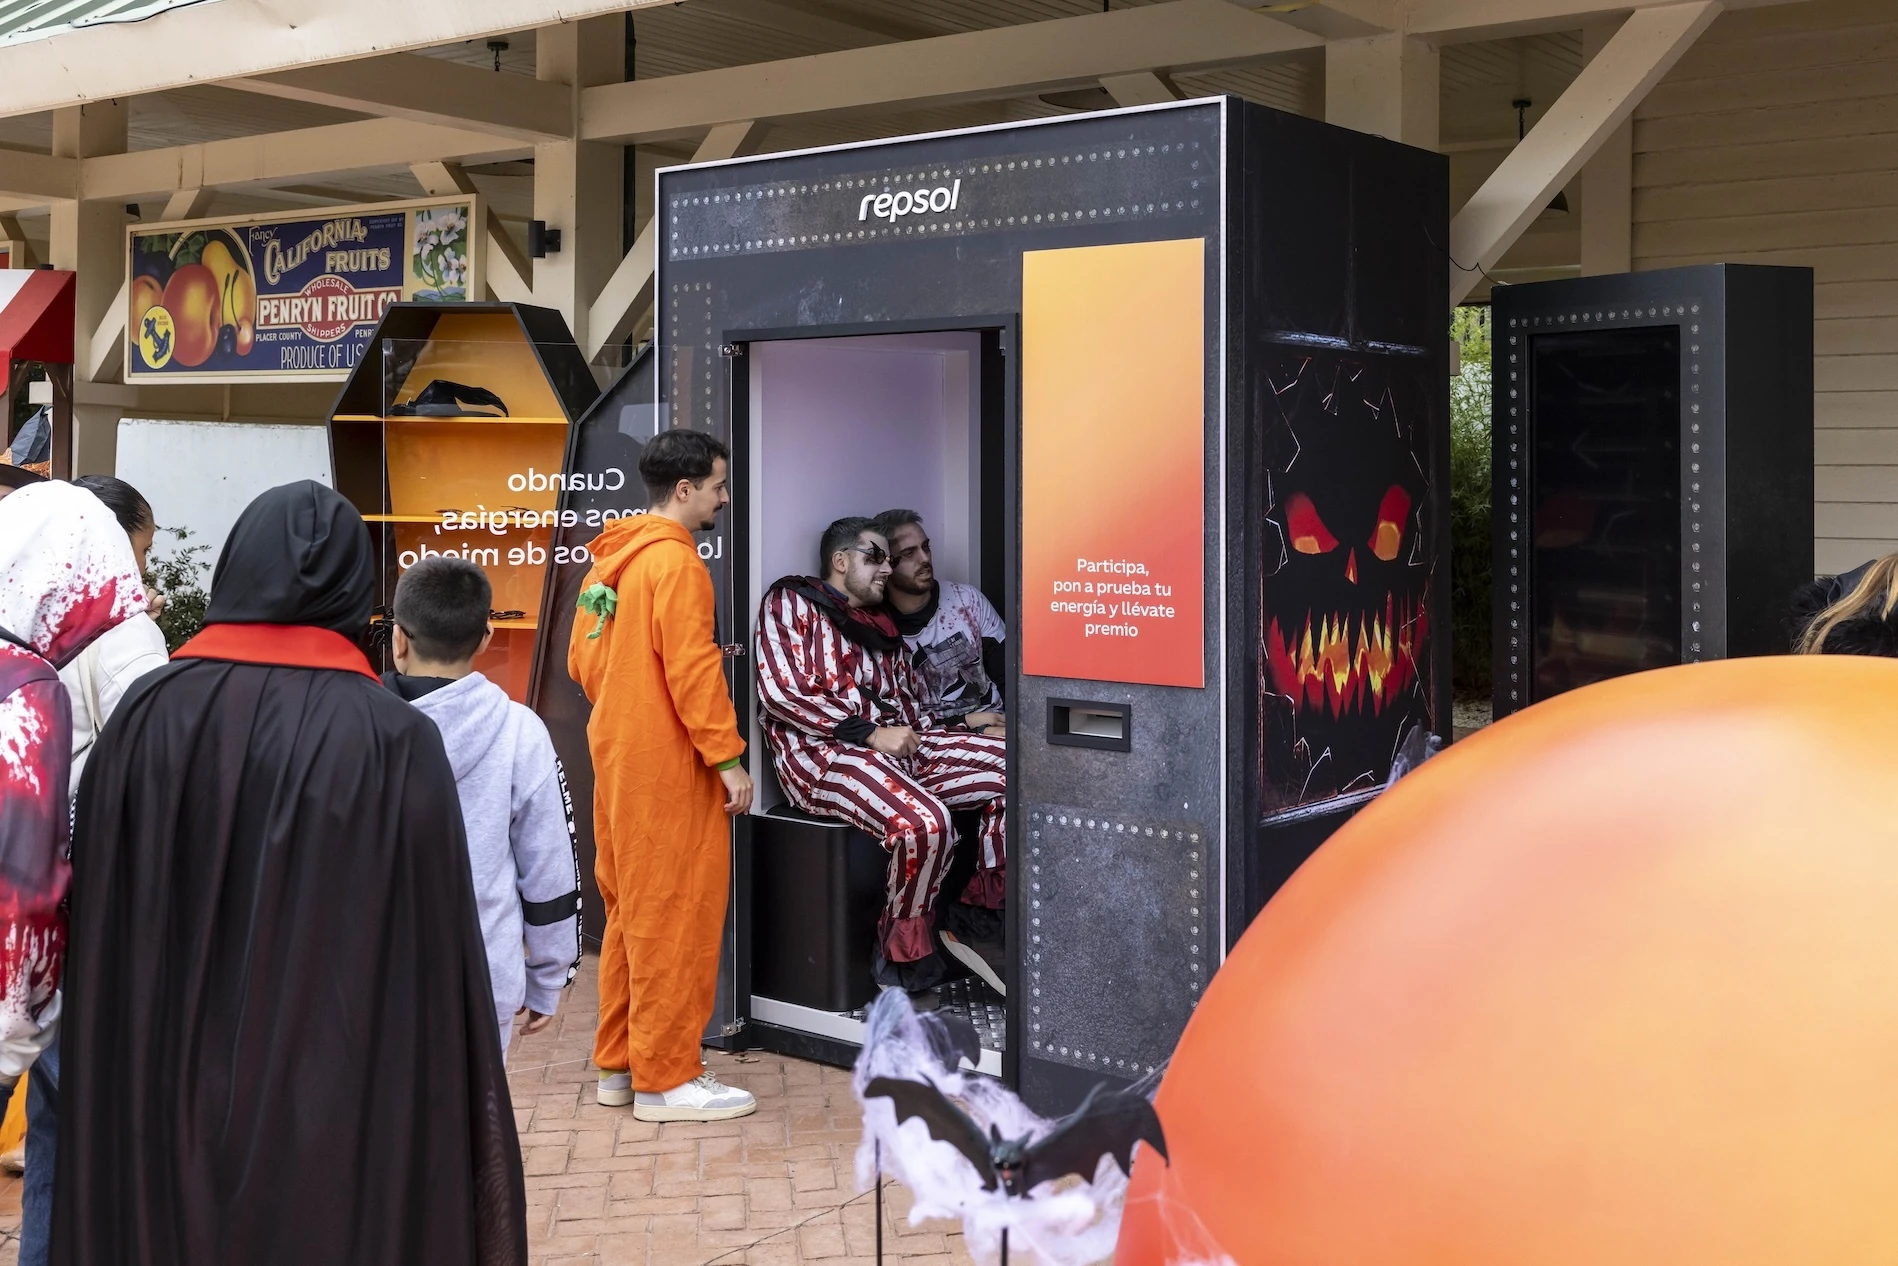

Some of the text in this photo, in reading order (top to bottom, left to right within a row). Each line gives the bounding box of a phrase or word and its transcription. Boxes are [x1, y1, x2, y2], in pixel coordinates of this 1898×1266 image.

[859, 179, 961, 222] repsol
[249, 226, 278, 256] Fancy
[264, 218, 368, 285] CALIFORNIA
[325, 247, 391, 273] FRUITS
[304, 278, 349, 297] WHOLESALE
[259, 296, 323, 325] PENRYN
[327, 293, 375, 321] FRUIT
[256, 331, 303, 342] PLACER COUNTY
[306, 323, 346, 338] SHIPPERS
[355, 328, 374, 338] PENR
[280, 345, 326, 369] PRODUCE
[328, 344, 344, 368] OF
[1077, 558, 1149, 577] Participa,
[1053, 580, 1172, 596] pon a prueba tu
[1050, 600, 1175, 618] energía y llévate
[1085, 622, 1139, 637] premio
